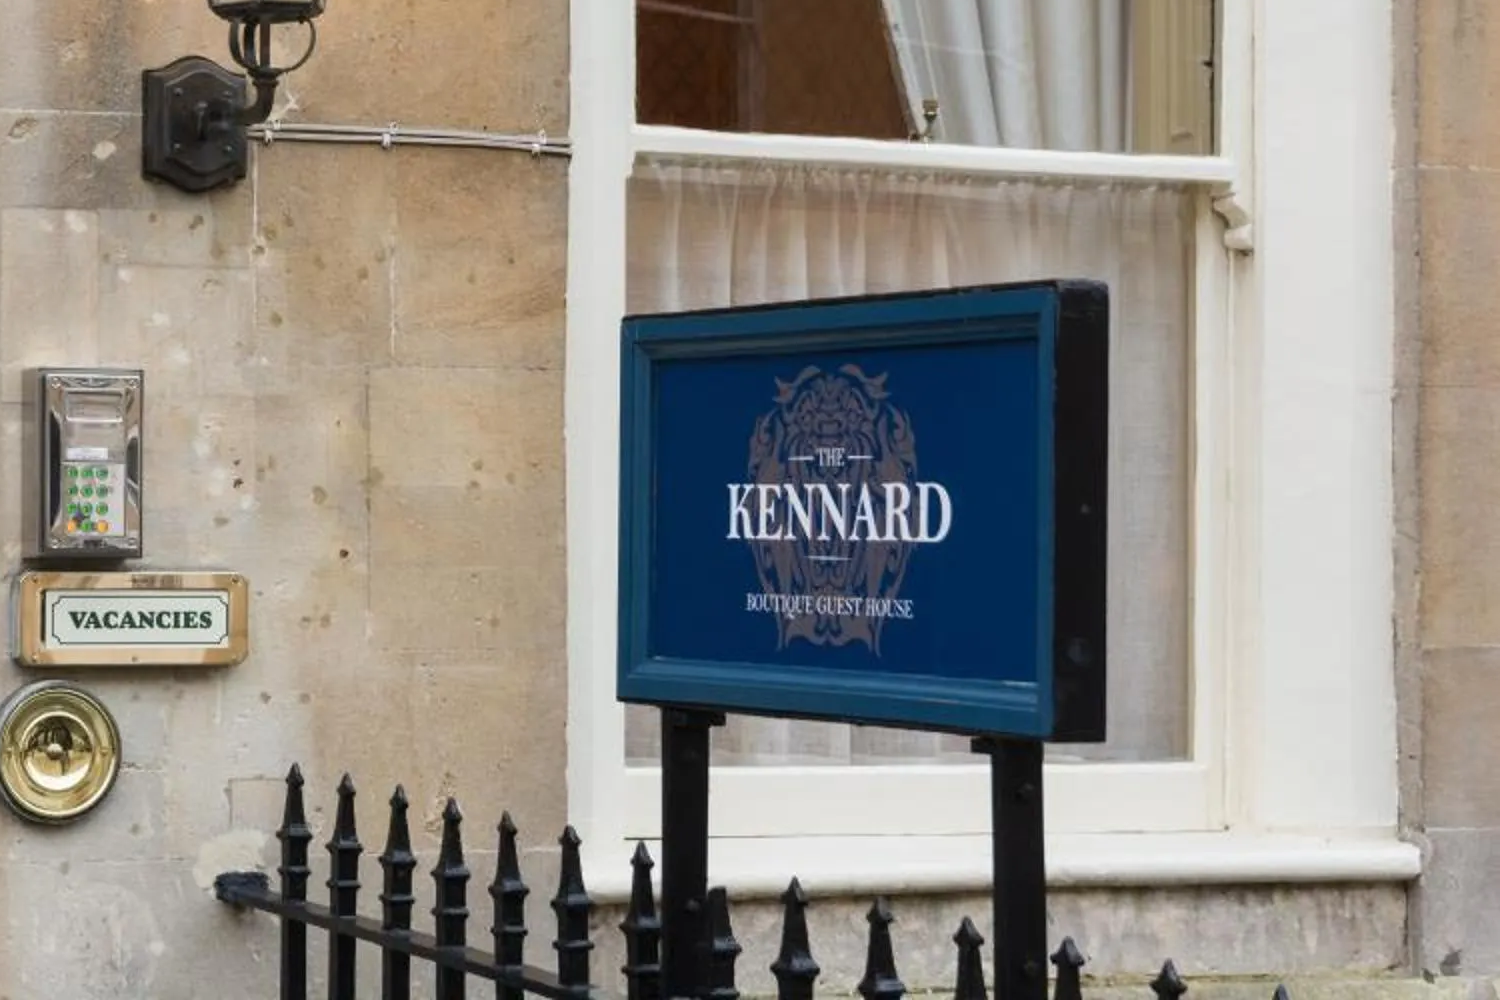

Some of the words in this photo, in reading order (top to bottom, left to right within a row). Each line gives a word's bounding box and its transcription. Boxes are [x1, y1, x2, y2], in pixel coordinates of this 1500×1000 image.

[815, 447, 846, 467] THE
[726, 482, 952, 543] KENNARD
[745, 593, 814, 619] BOUTIQUE
[816, 595, 862, 617] GUEST
[865, 599, 915, 619] HOUSE
[68, 610, 213, 629] VACANCIES
